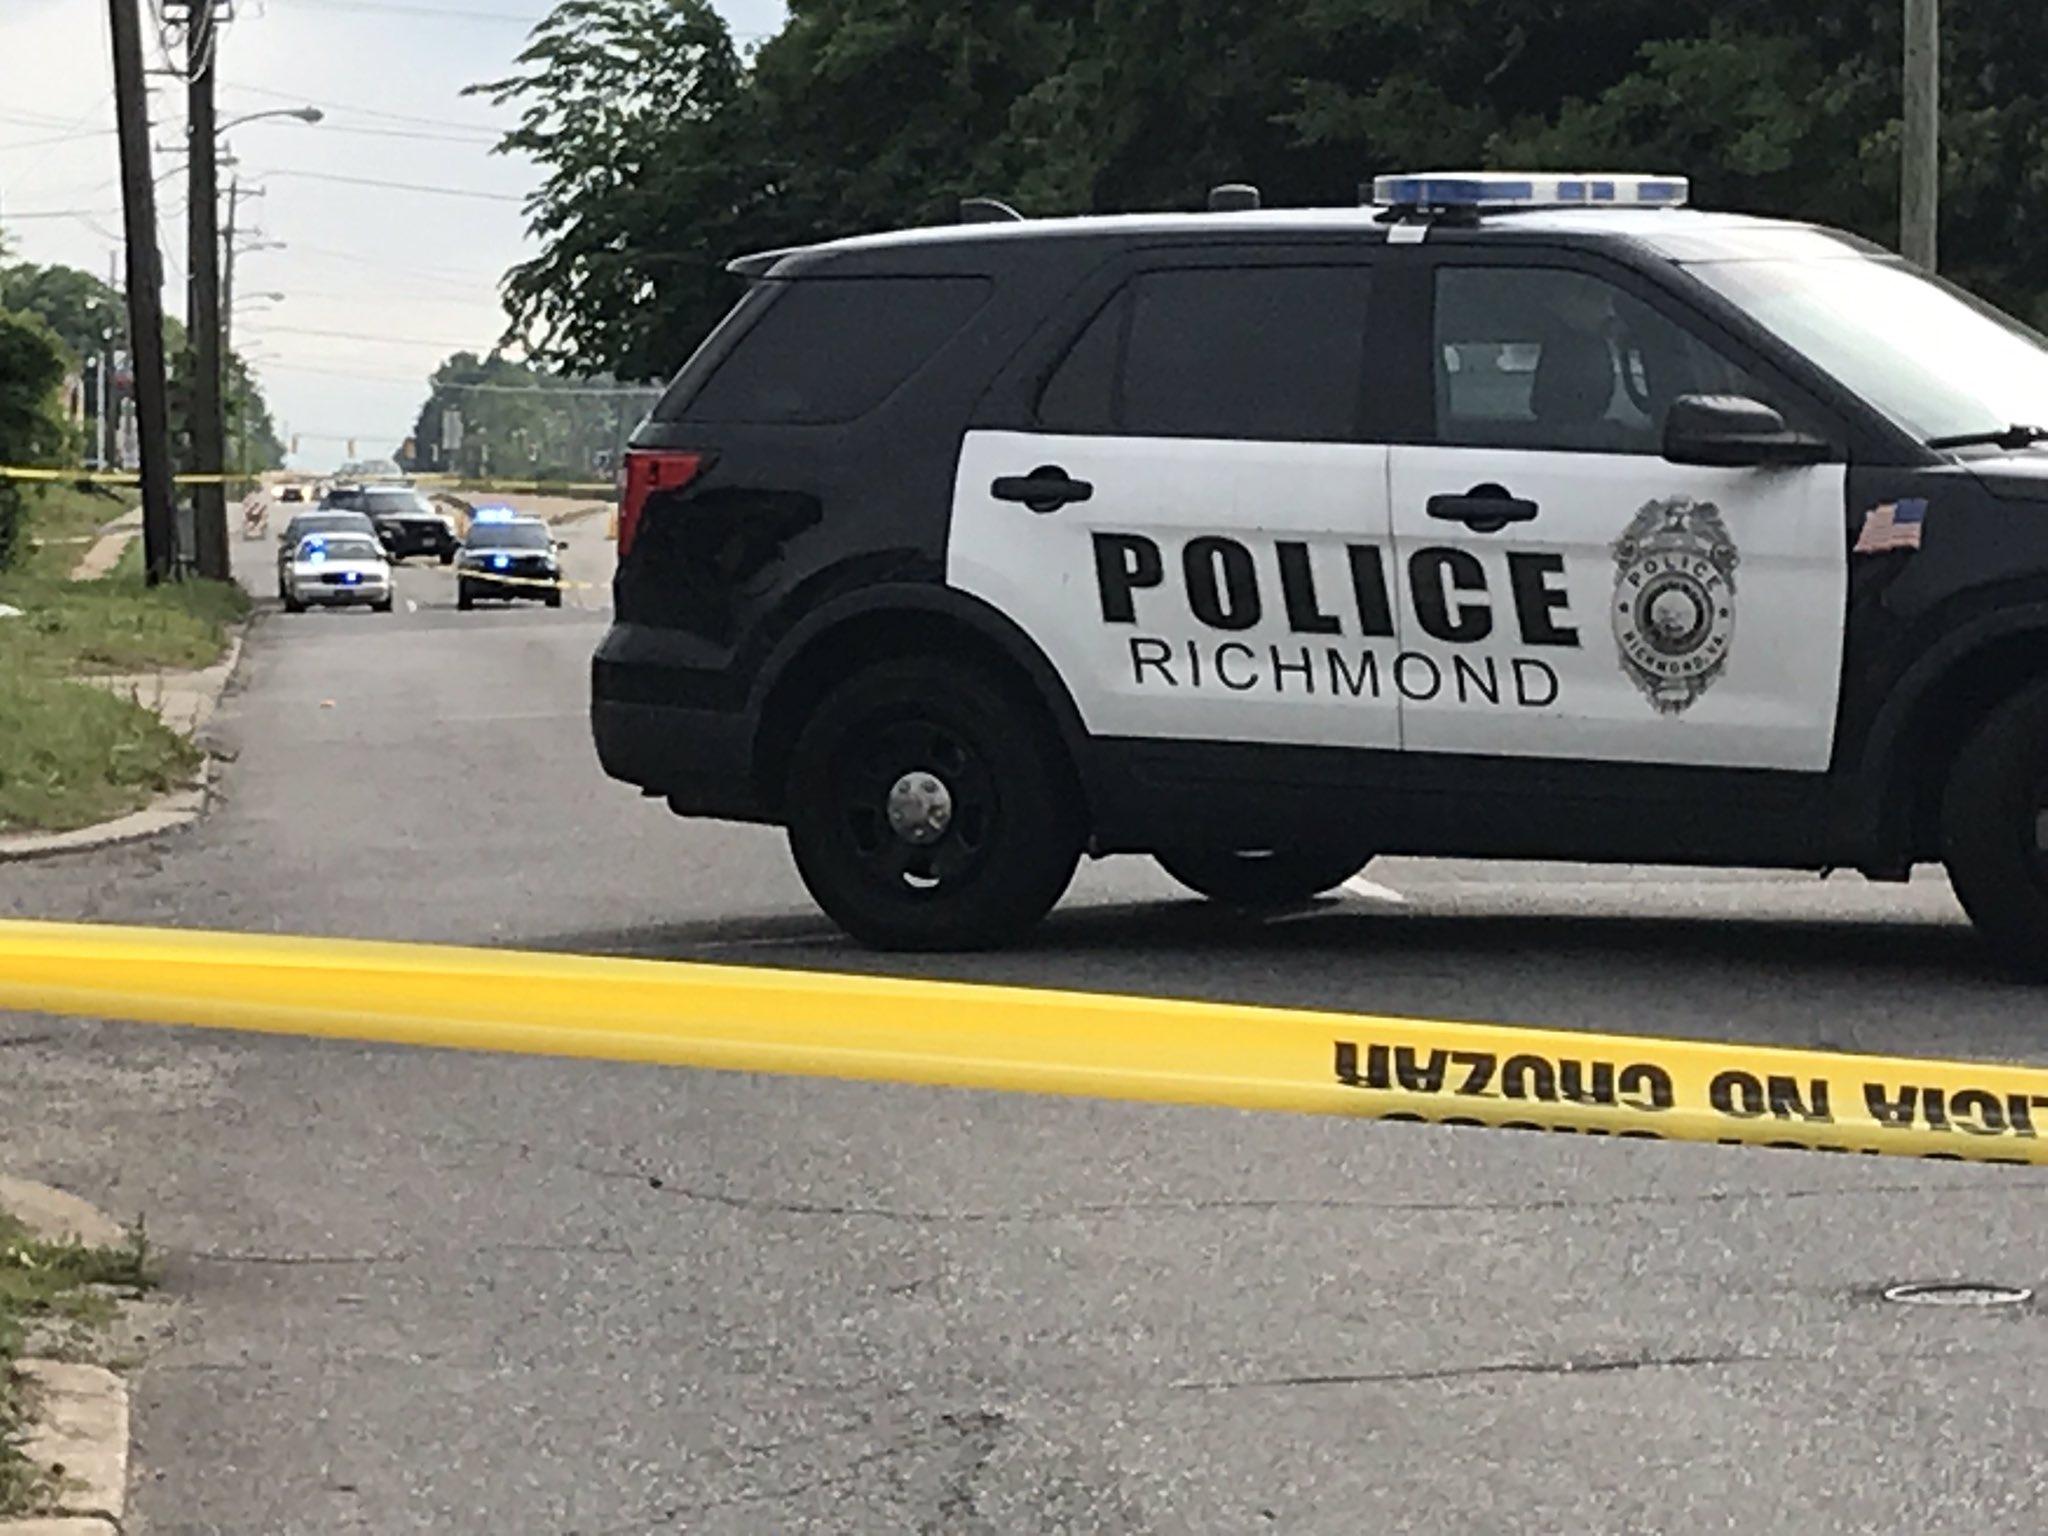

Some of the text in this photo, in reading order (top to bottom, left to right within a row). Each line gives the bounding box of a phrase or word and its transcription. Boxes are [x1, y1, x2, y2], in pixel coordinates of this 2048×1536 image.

[1091, 530, 1582, 648] POLICE
[1627, 556, 1722, 590] POLICE
[1130, 637, 1558, 706] RICHMOND
[1334, 1041, 1675, 1111] CRUZAR
[1709, 1070, 1834, 1124] NO
